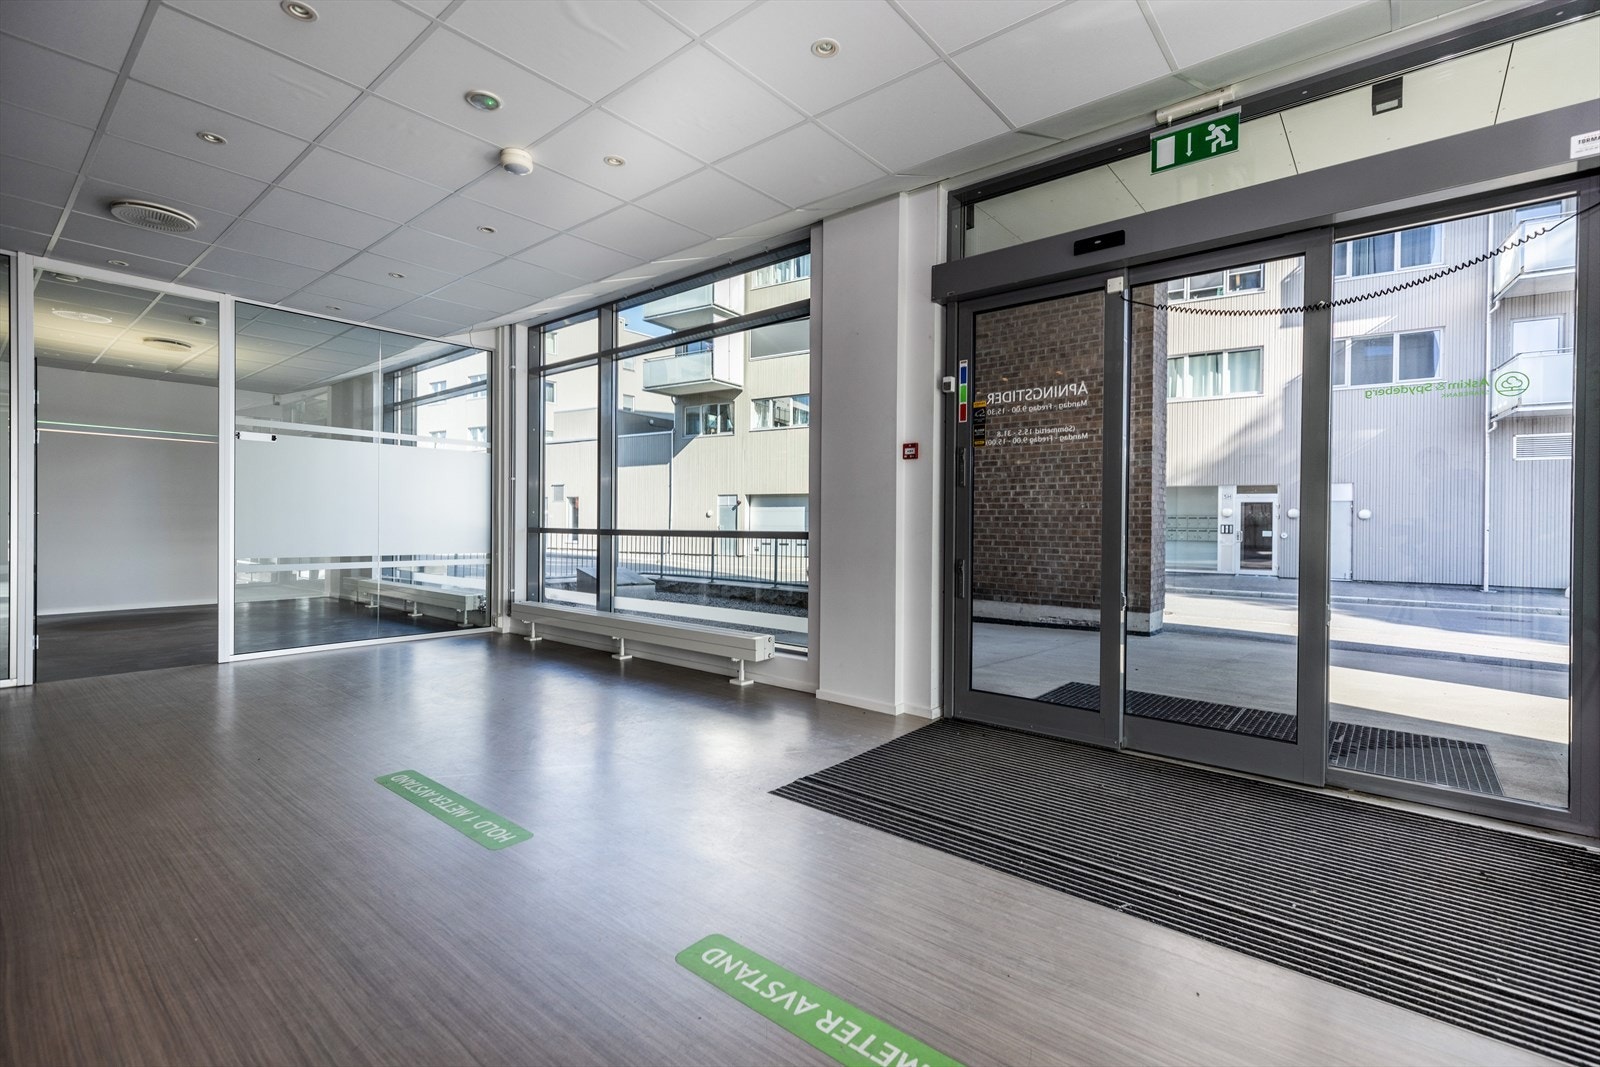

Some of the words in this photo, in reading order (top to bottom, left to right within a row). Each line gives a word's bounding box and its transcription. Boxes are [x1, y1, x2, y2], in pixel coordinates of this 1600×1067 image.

[390, 774, 437, 798] AVSTAND
[428, 795, 474, 818] METER
[463, 814, 481, 823] 1
[473, 820, 517, 843] HOLD
[701, 948, 820, 1016] AVSTAND
